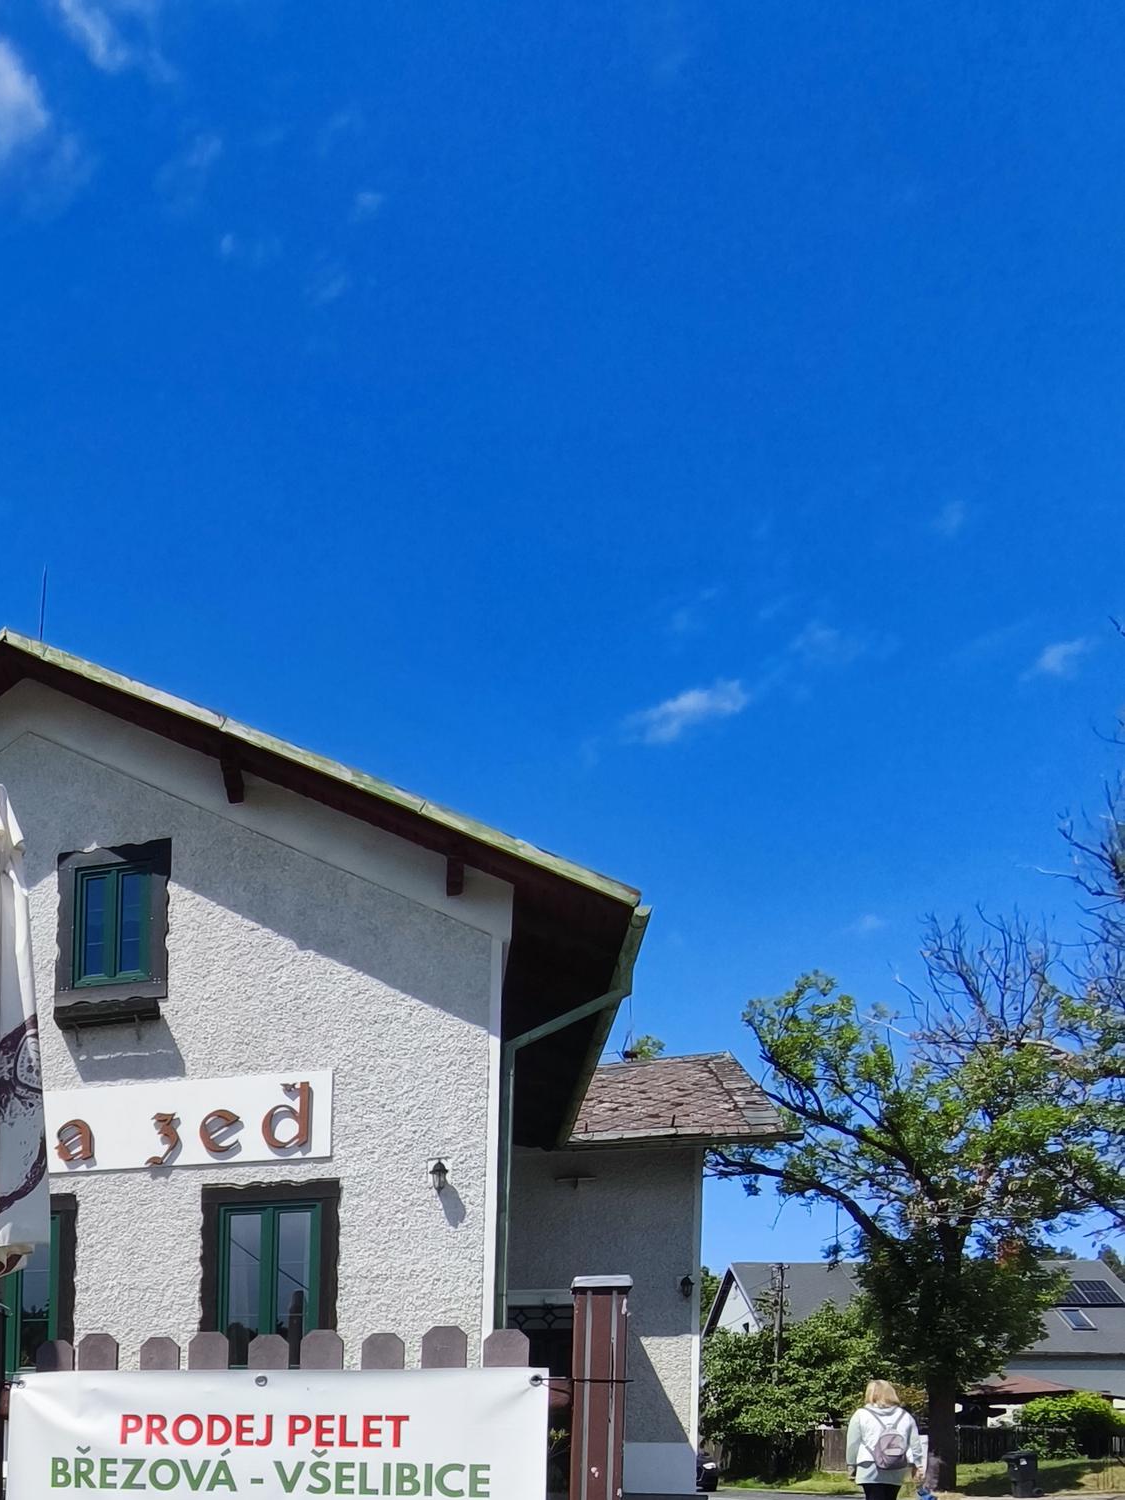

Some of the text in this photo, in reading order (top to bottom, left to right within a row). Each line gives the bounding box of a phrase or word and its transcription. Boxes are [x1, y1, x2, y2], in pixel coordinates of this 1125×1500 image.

[120, 1413, 410, 1449] PRODEJ PELET
[51, 1446, 237, 1492] BŘEZOVÁ
[273, 1449, 491, 1499] VŠELIBICE
